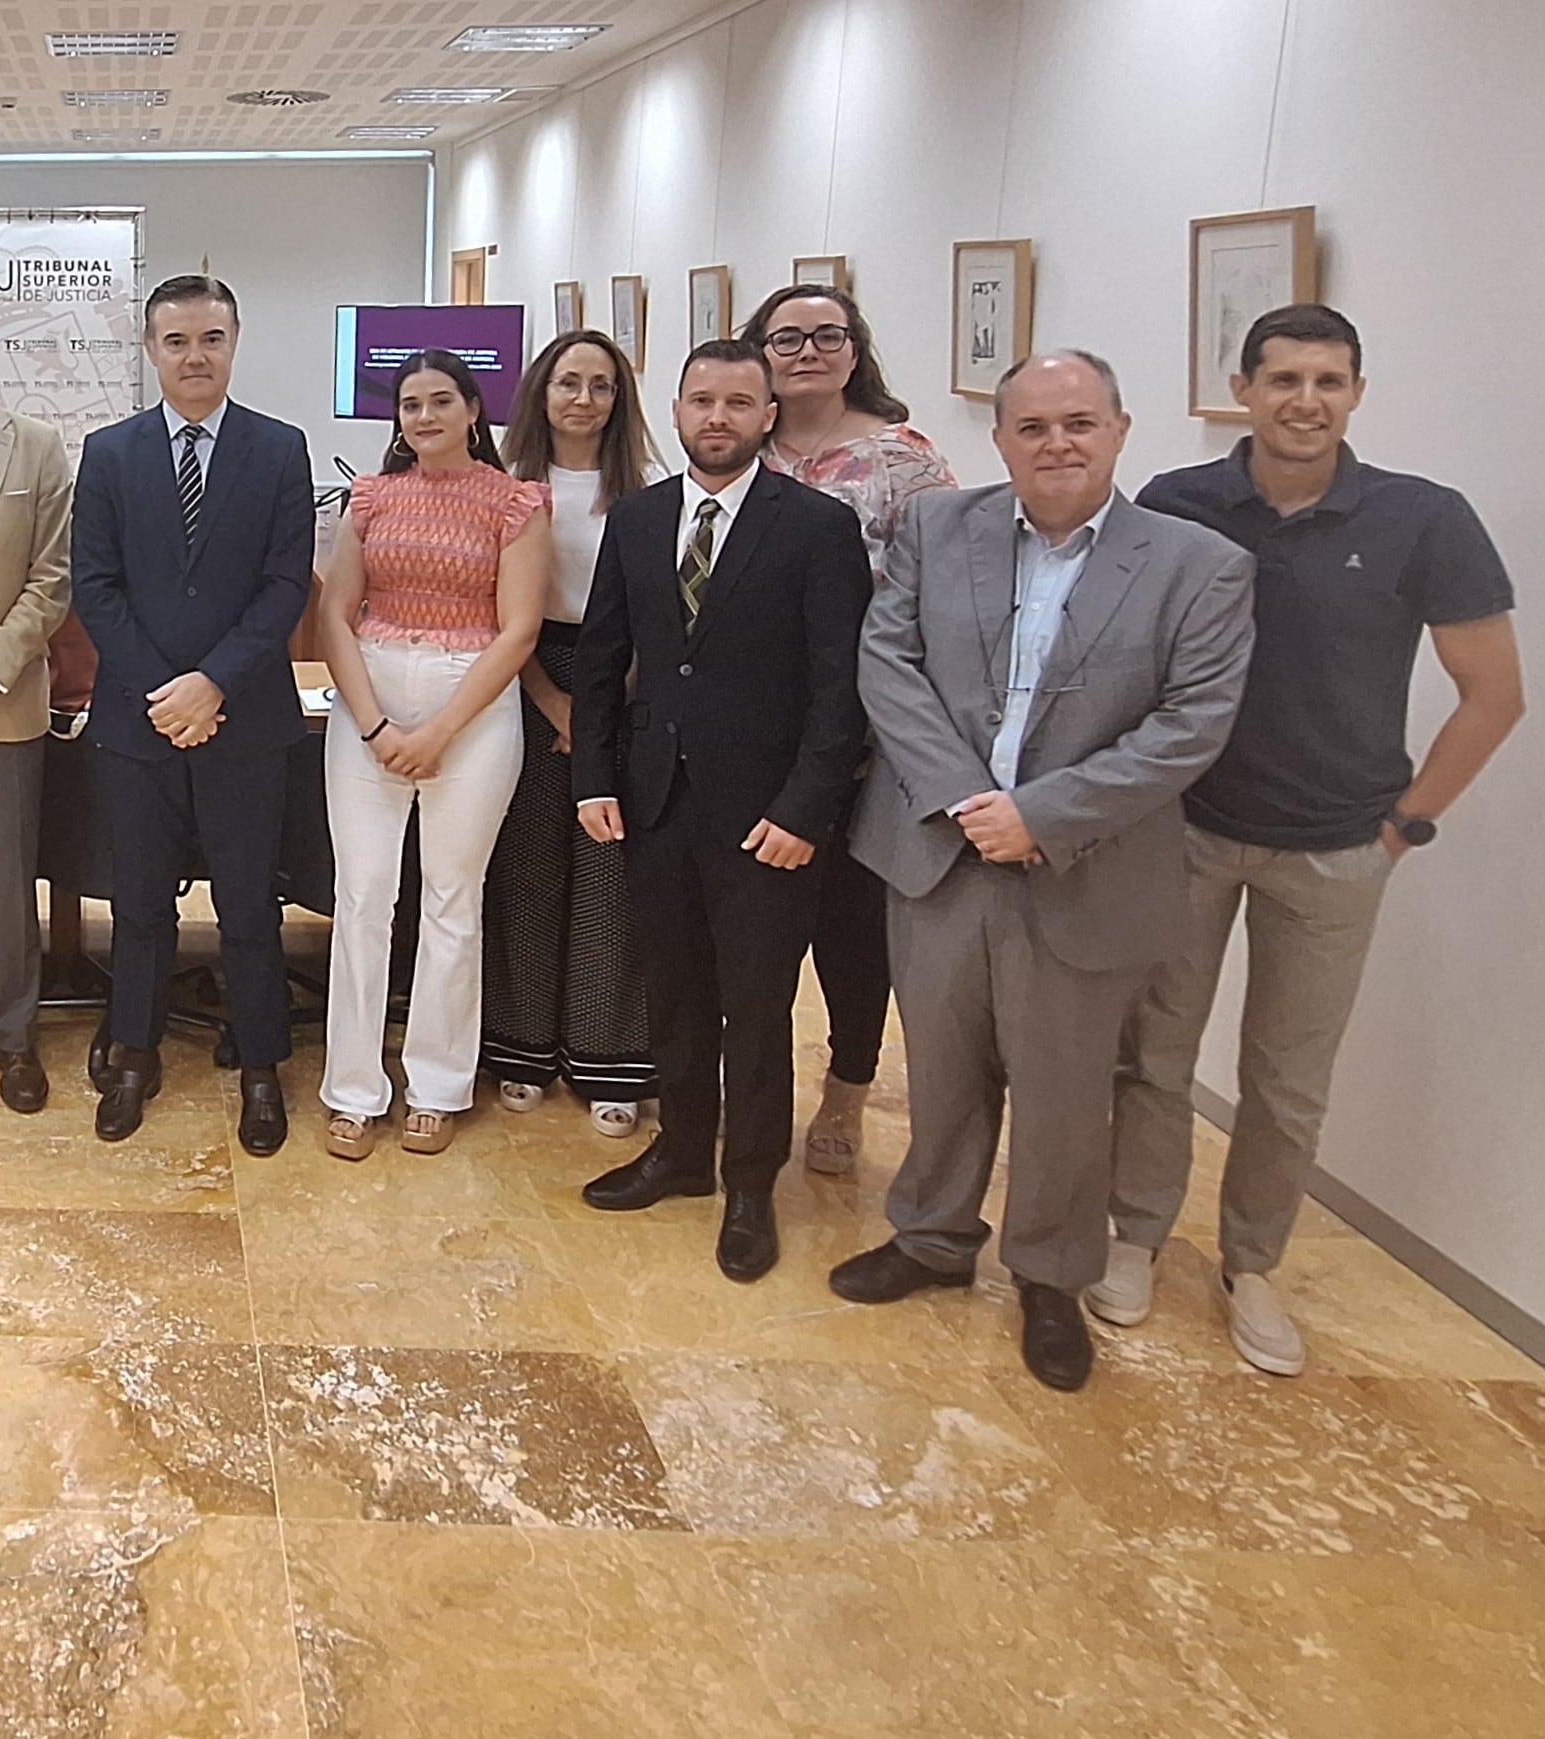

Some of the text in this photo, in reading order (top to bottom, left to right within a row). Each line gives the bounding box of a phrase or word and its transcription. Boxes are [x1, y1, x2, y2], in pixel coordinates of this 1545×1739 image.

[22, 260, 112, 272] TRIBUNAL
[22, 275, 112, 287] SUPERIOR
[22, 290, 43, 302] DE
[47, 289, 112, 302] JUSTICIA
